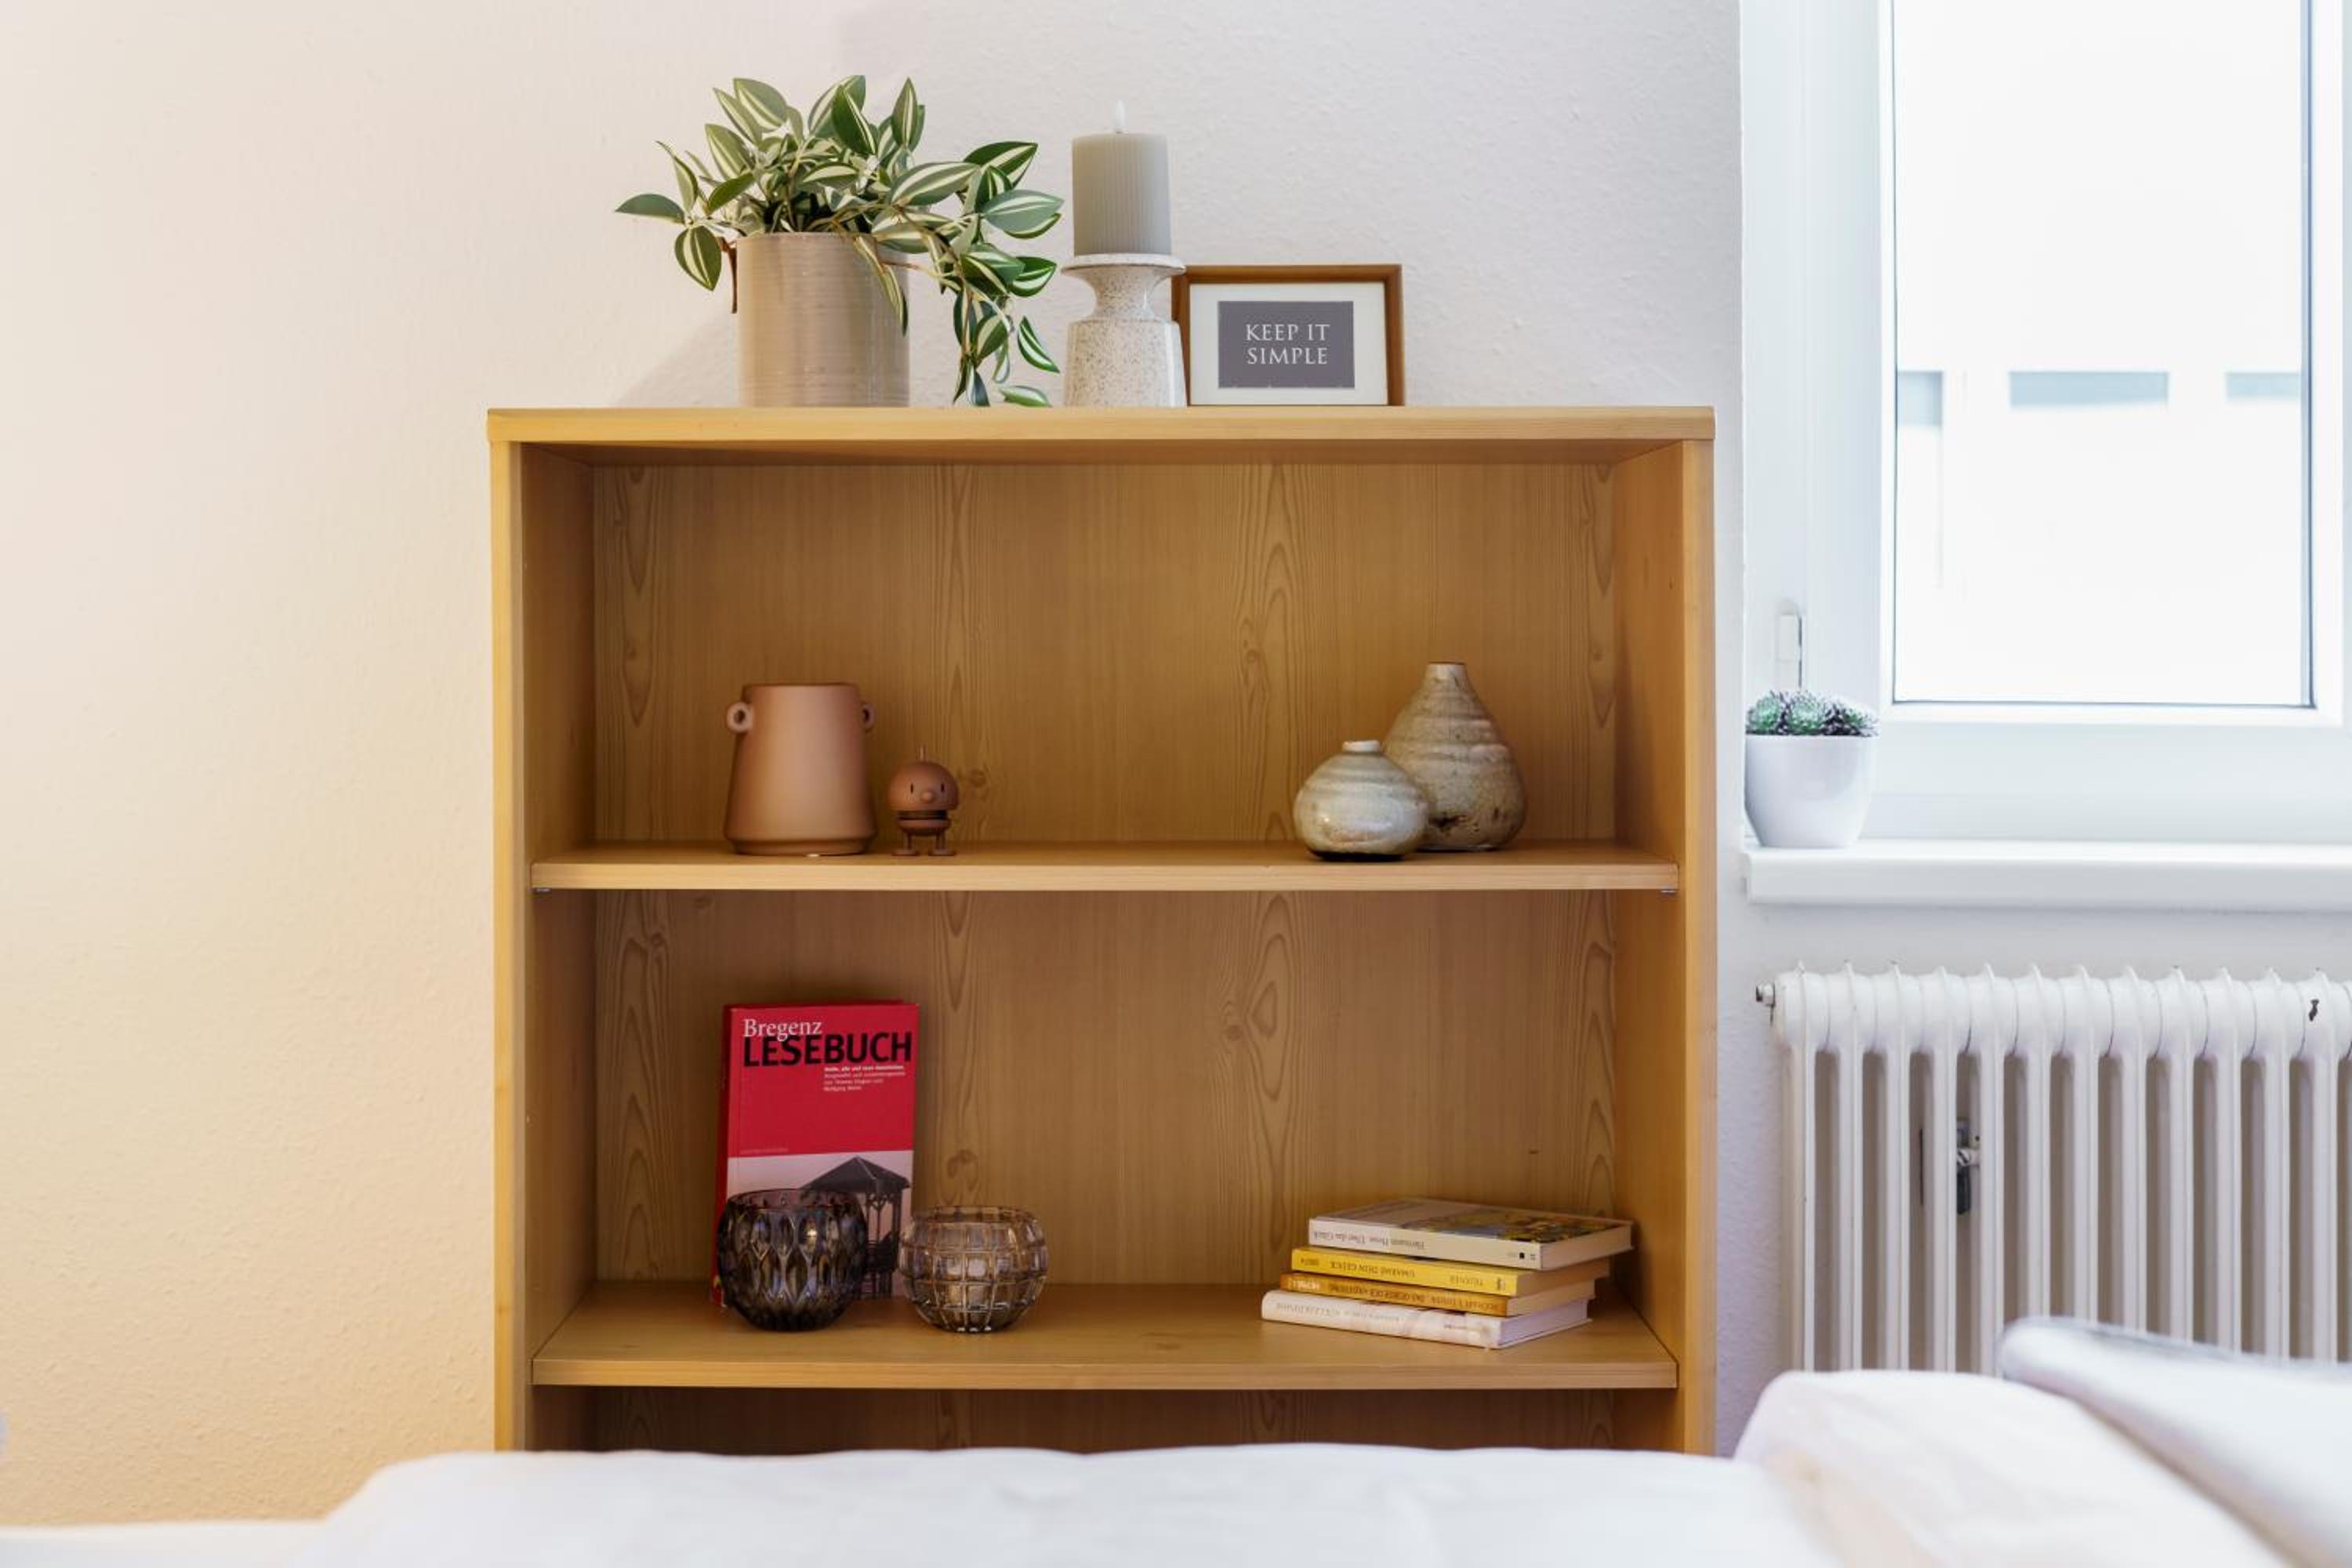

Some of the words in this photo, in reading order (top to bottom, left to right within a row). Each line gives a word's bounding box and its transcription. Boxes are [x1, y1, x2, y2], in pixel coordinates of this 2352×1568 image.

[1246, 324, 1299, 341] KEEP
[1308, 324, 1330, 341] IT
[1247, 347, 1327, 365] SIMPLE
[744, 1018, 822, 1042] Bregenz
[744, 1031, 912, 1066] LESEBUCH
